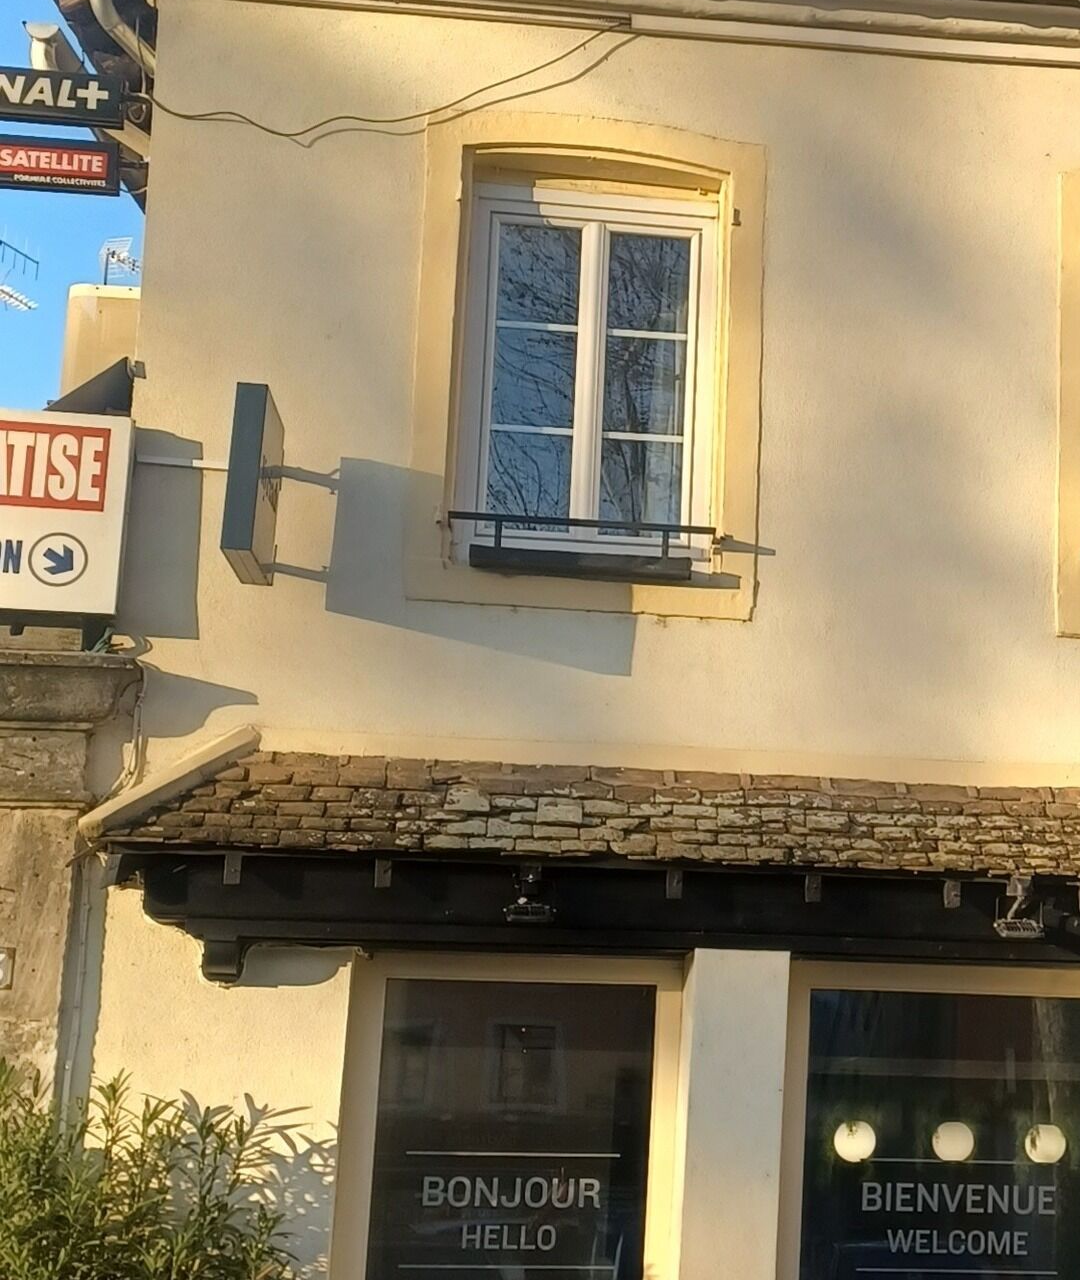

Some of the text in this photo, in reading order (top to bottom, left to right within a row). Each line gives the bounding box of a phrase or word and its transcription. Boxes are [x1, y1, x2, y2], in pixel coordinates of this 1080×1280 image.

[0, 74, 109, 110] NAL+
[0, 148, 104, 173] SATELLITE
[0, 539, 23, 575] N
[421, 1176, 602, 1210] BONJOUR
[860, 1181, 1057, 1216] BIENVENUE
[460, 1224, 557, 1251] HELLO
[887, 1228, 1029, 1257] WELCOME
